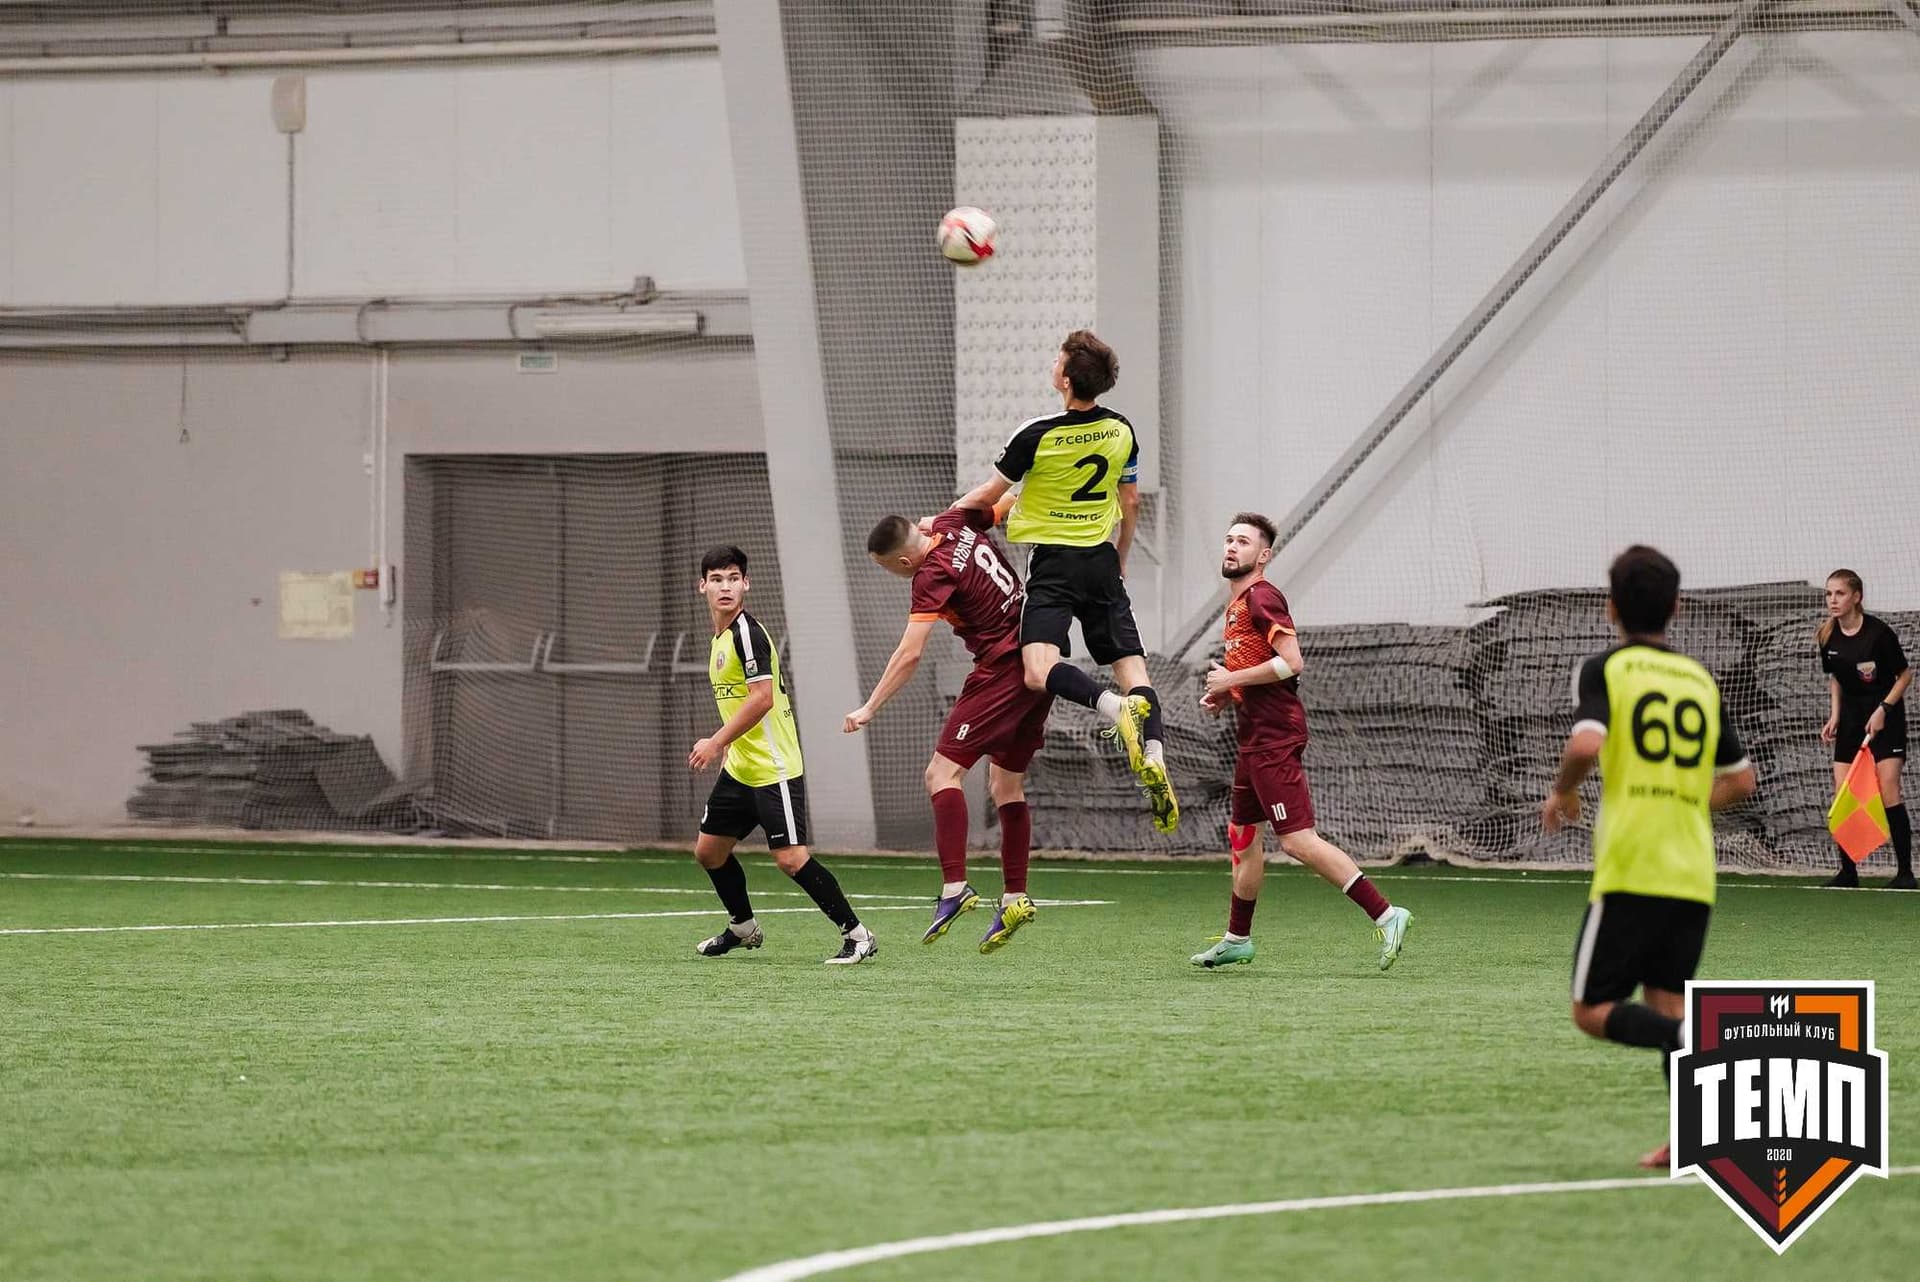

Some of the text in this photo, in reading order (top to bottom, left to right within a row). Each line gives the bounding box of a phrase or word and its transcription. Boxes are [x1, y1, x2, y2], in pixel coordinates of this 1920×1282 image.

[1071, 454, 1109, 501] 2
[974, 544, 1015, 596] 8
[955, 723, 970, 740] 8
[1632, 691, 1707, 768] 69
[1271, 802, 1287, 821] 10
